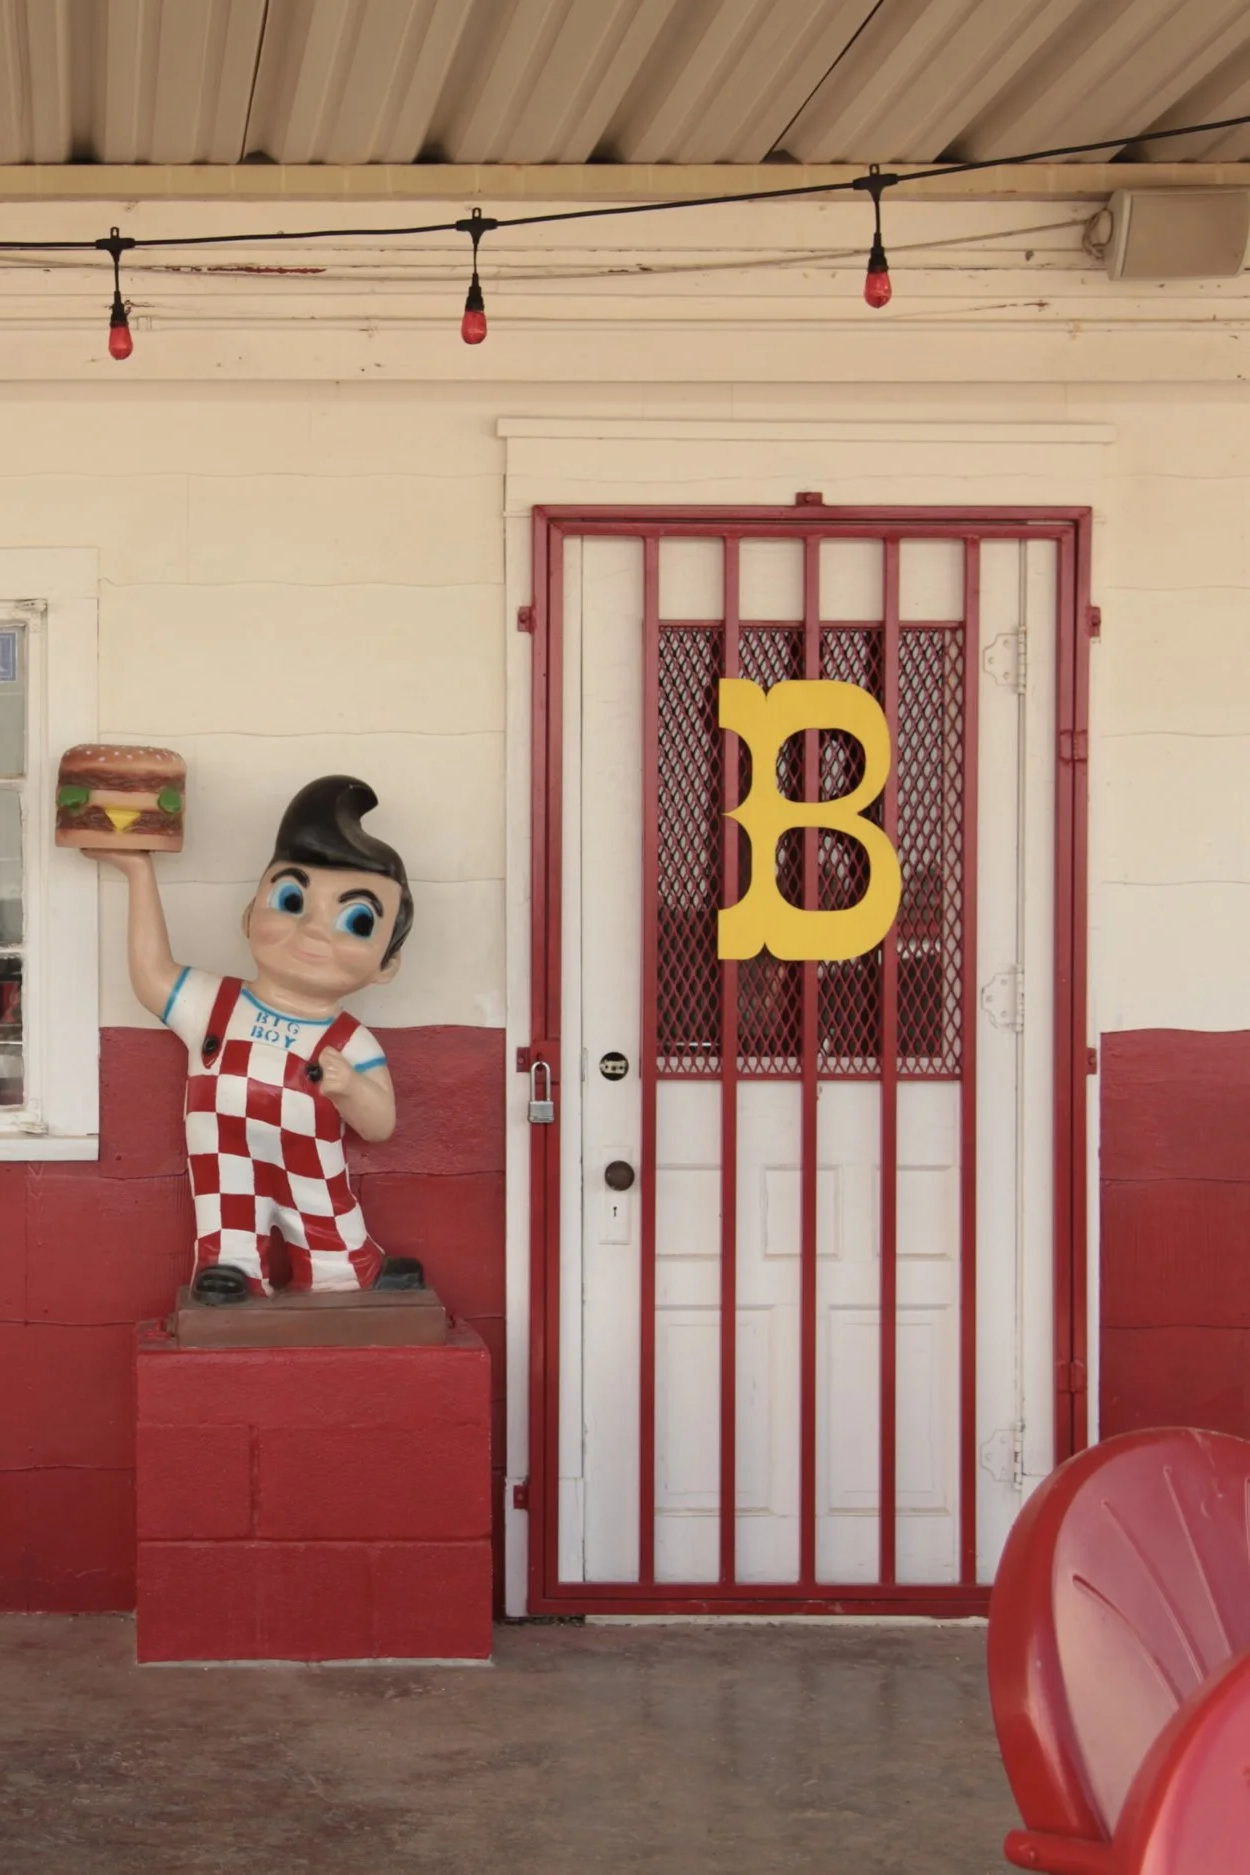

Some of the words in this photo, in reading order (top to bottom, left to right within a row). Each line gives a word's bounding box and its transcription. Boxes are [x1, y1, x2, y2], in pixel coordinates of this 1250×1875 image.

[717, 677, 901, 961] B
[255, 1012, 300, 1034] BIG
[250, 1026, 296, 1048] BOY
